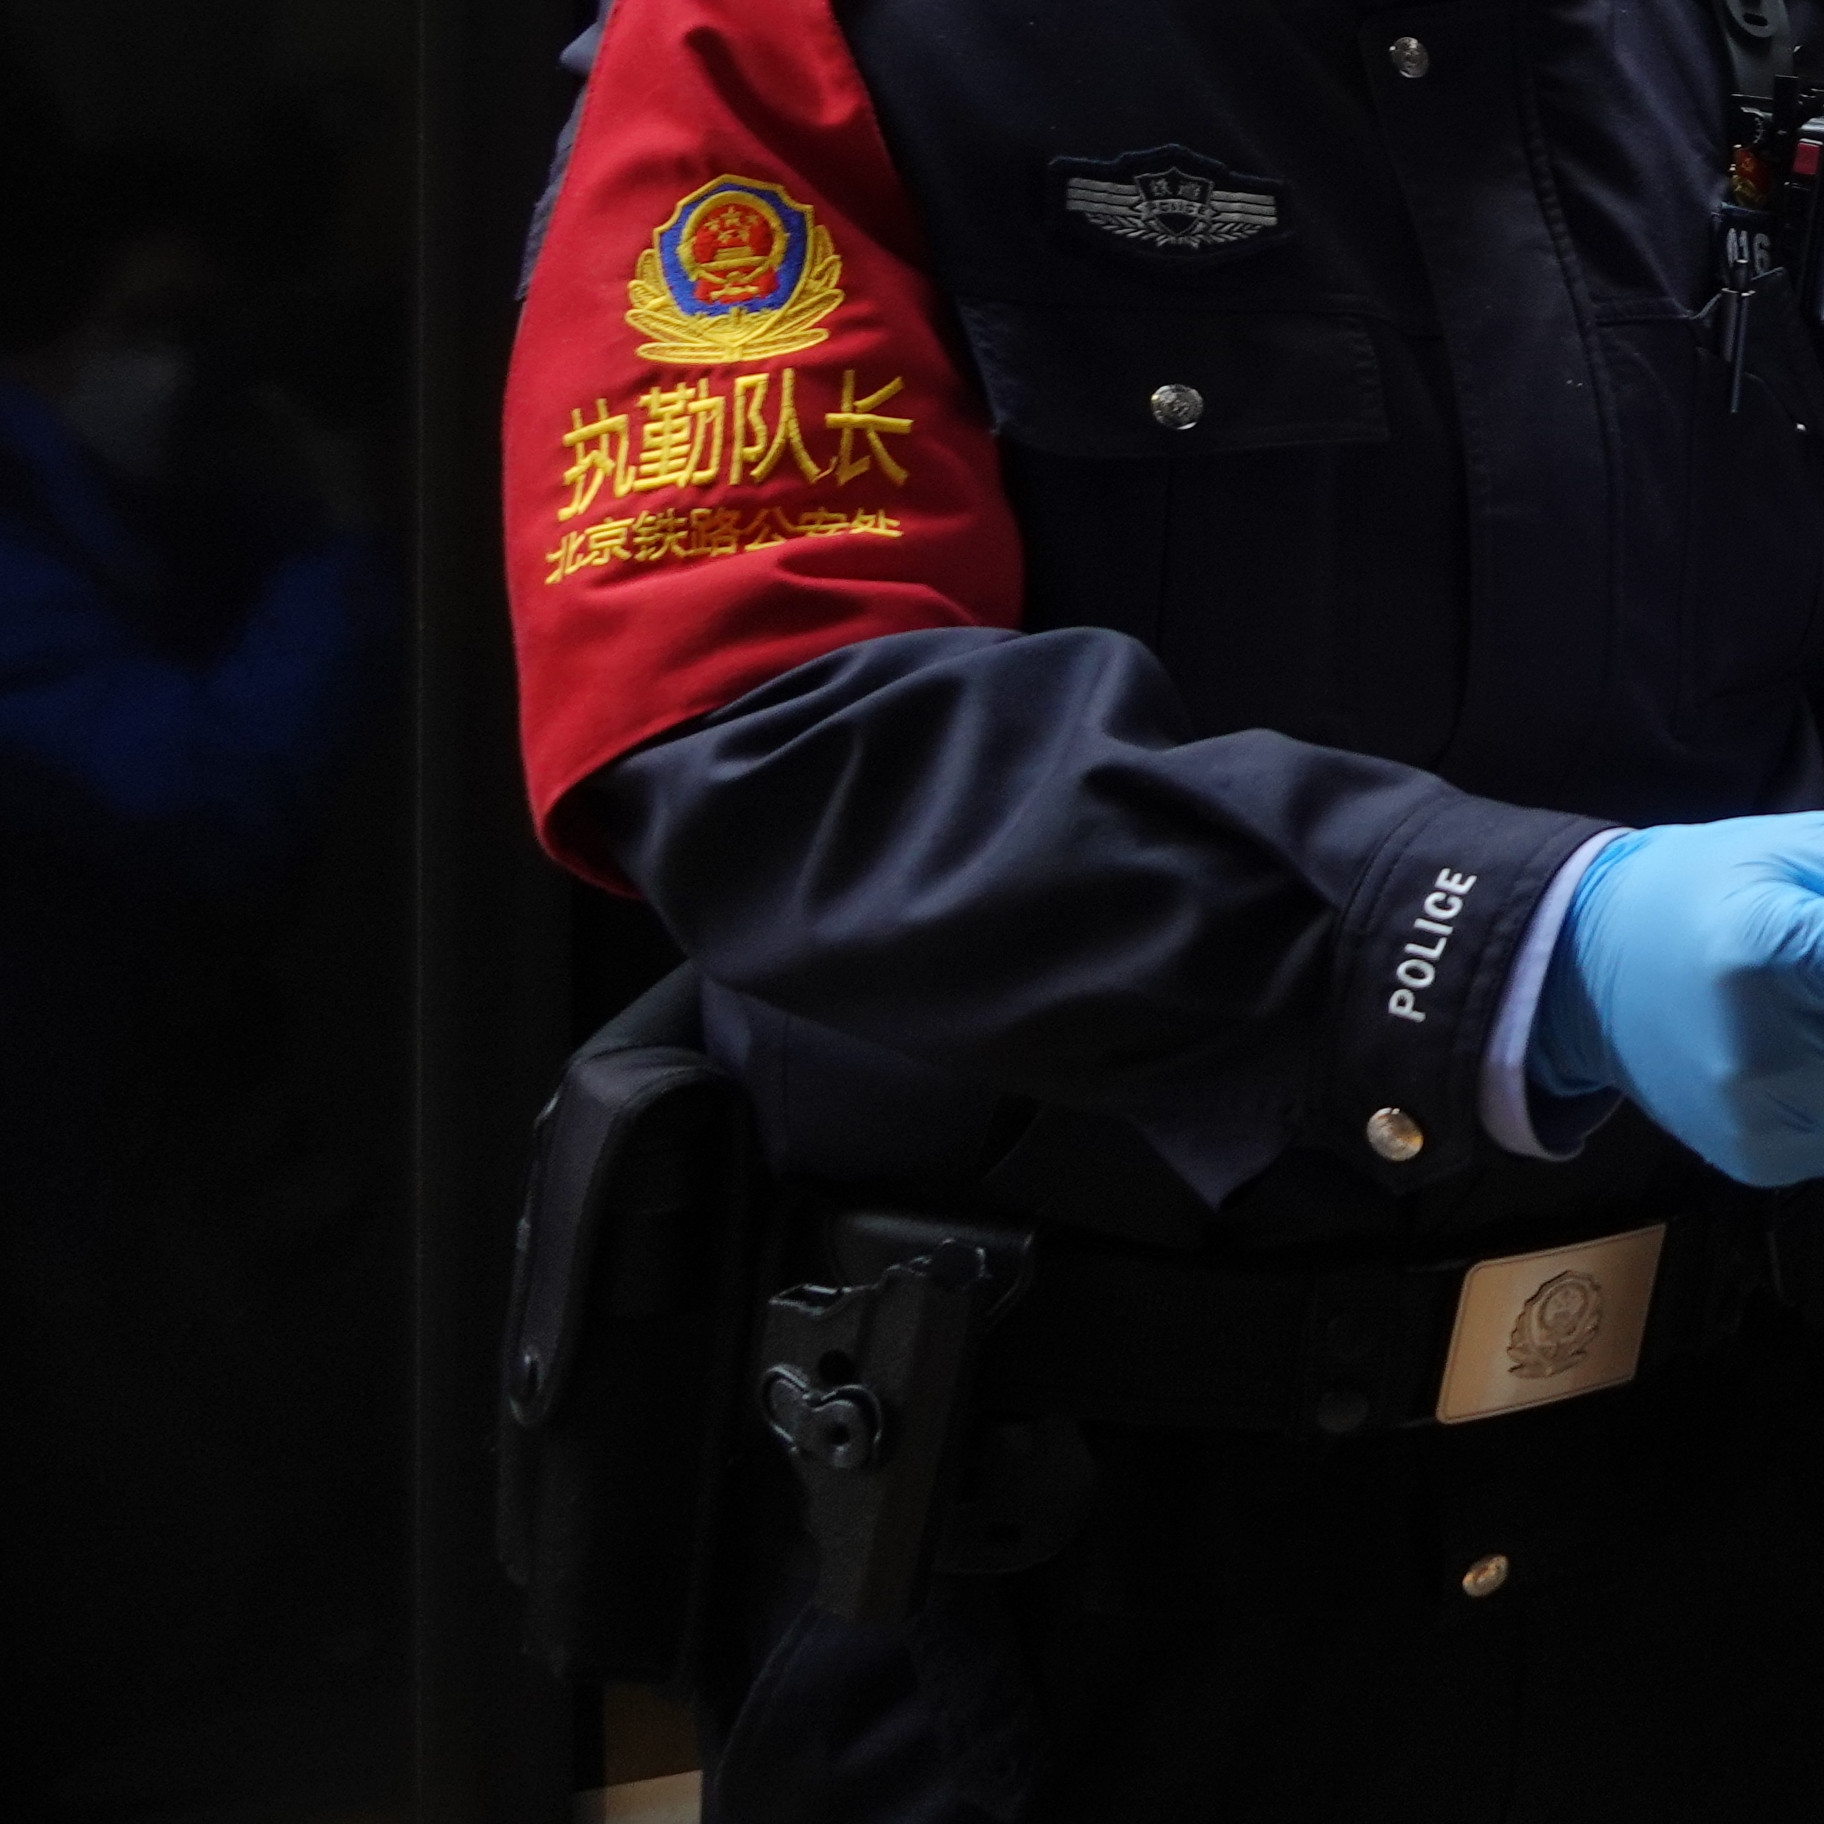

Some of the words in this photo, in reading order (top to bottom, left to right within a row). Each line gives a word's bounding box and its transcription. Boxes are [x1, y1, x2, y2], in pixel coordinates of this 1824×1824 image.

[557, 368, 914, 522] 执勤队长
[1387, 867, 1478, 1024] POLICE
